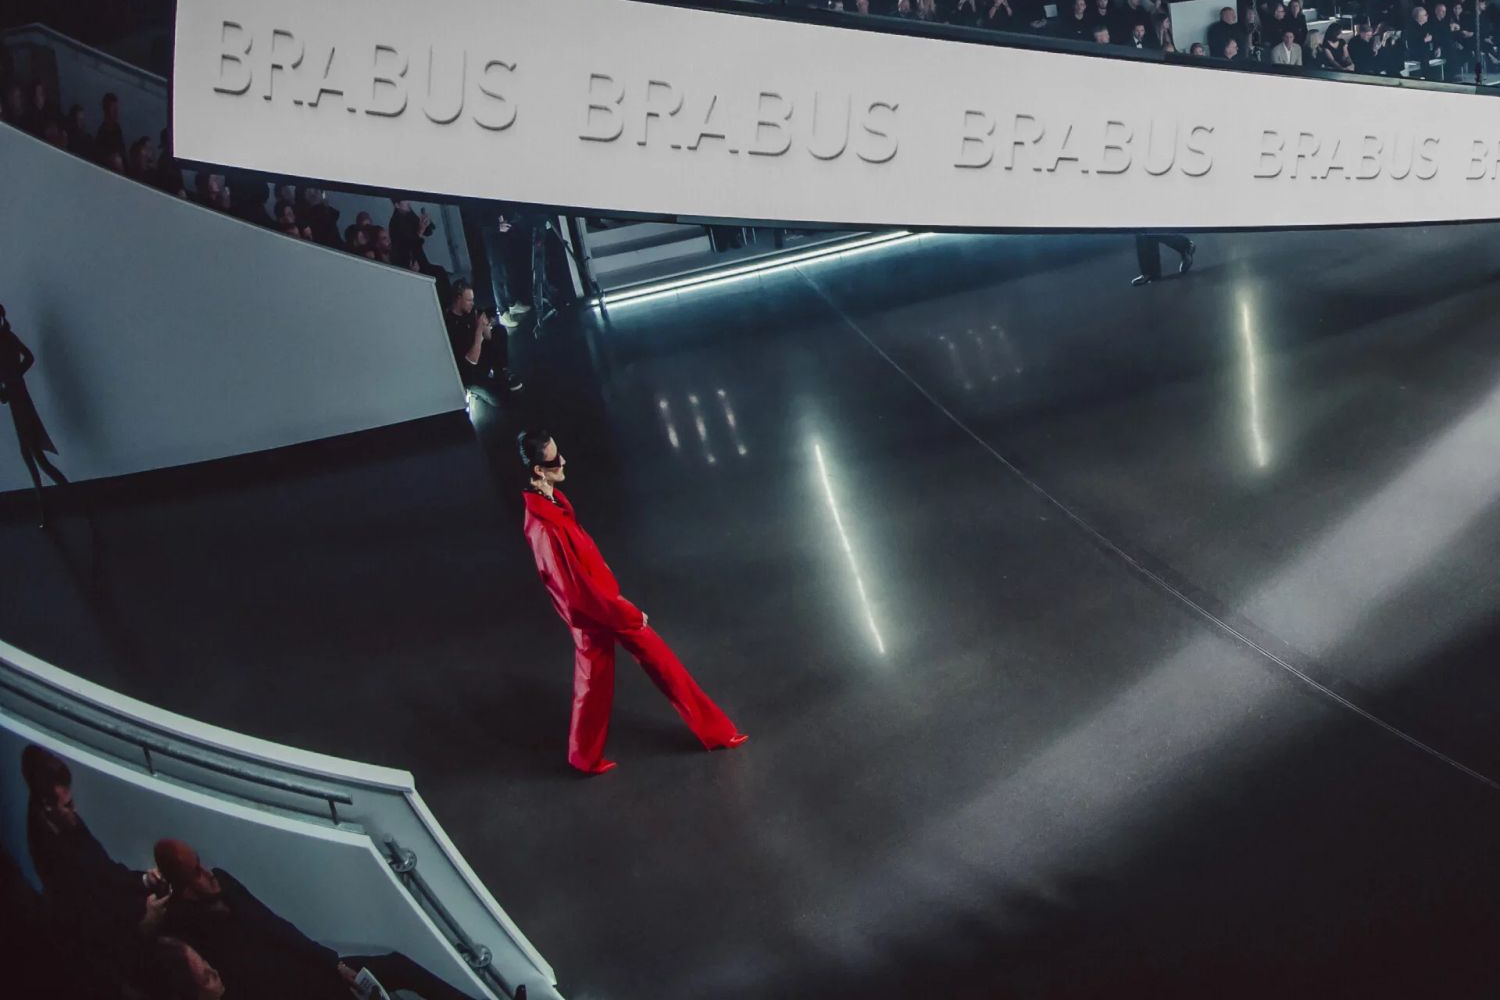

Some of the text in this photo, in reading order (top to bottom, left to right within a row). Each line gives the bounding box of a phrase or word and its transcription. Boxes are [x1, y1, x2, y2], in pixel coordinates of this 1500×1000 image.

[213, 20, 518, 132] BRABUS
[578, 72, 900, 164] BRABUS
[954, 110, 1214, 177] BRABUS
[1252, 129, 1440, 181] BRABUS
